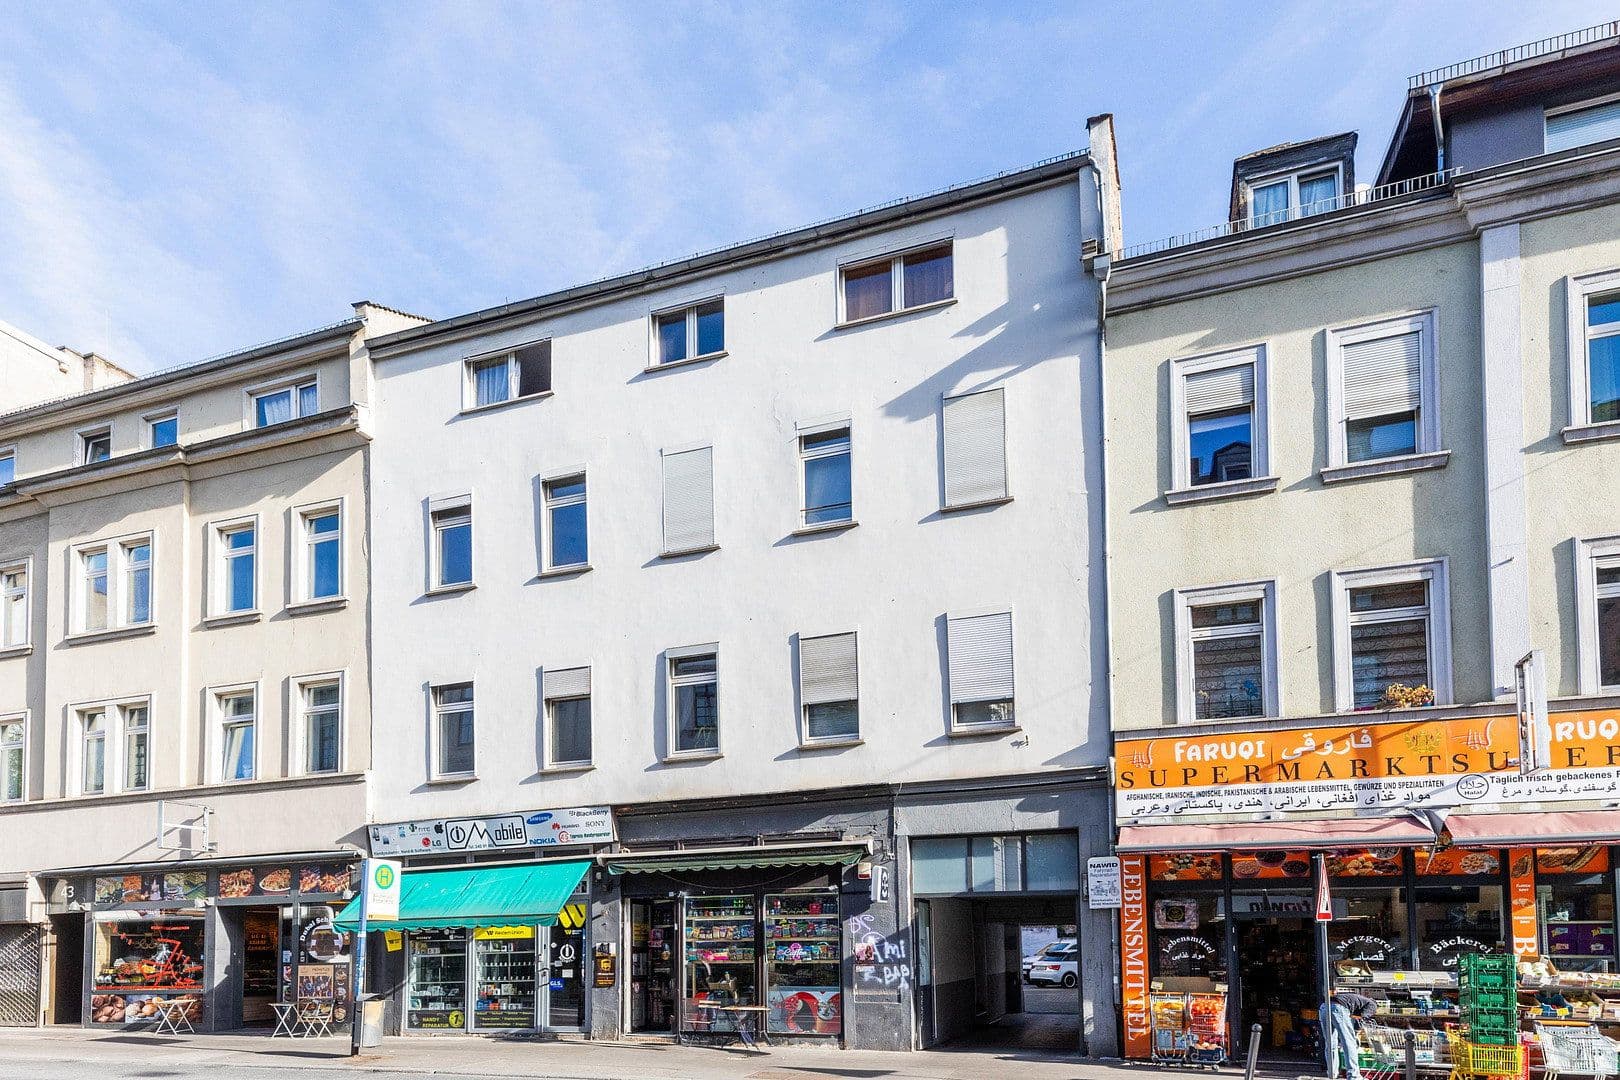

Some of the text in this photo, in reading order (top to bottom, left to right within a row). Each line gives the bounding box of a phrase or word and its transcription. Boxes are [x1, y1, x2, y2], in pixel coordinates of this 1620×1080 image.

[1549, 718, 1619, 742] RUQ
[1173, 740, 1266, 763] FARUQI
[1120, 754, 1441, 788] SUPERMARKT
[1490, 775, 1524, 784] Täglich
[1556, 771, 1613, 783] gebackenes
[1126, 793, 1164, 801] AFGHANISCHE,
[1165, 791, 1196, 799] IRANISCHE,
[1196, 790, 1223, 798] INDISCHE,
[1224, 788, 1268, 796] PAKISTANISCHE
[1274, 785, 1306, 794] ARABISCHE
[1307, 783, 1353, 793] LEBENSMITTEL,
[1354, 780, 1383, 791] GEWÜRZE
[1384, 781, 1397, 790] UND
[1398, 779, 1445, 789] SPEZIALITÄTEN
[529, 837, 556, 845] NOKIA
[61, 886, 75, 898] 43
[1122, 859, 1146, 1041] LEBENSMITTEL
[1162, 936, 1216, 954] Lebensmittel
[1335, 935, 1397, 953] Metzgerei
[1429, 935, 1494, 955] Bäckerei
